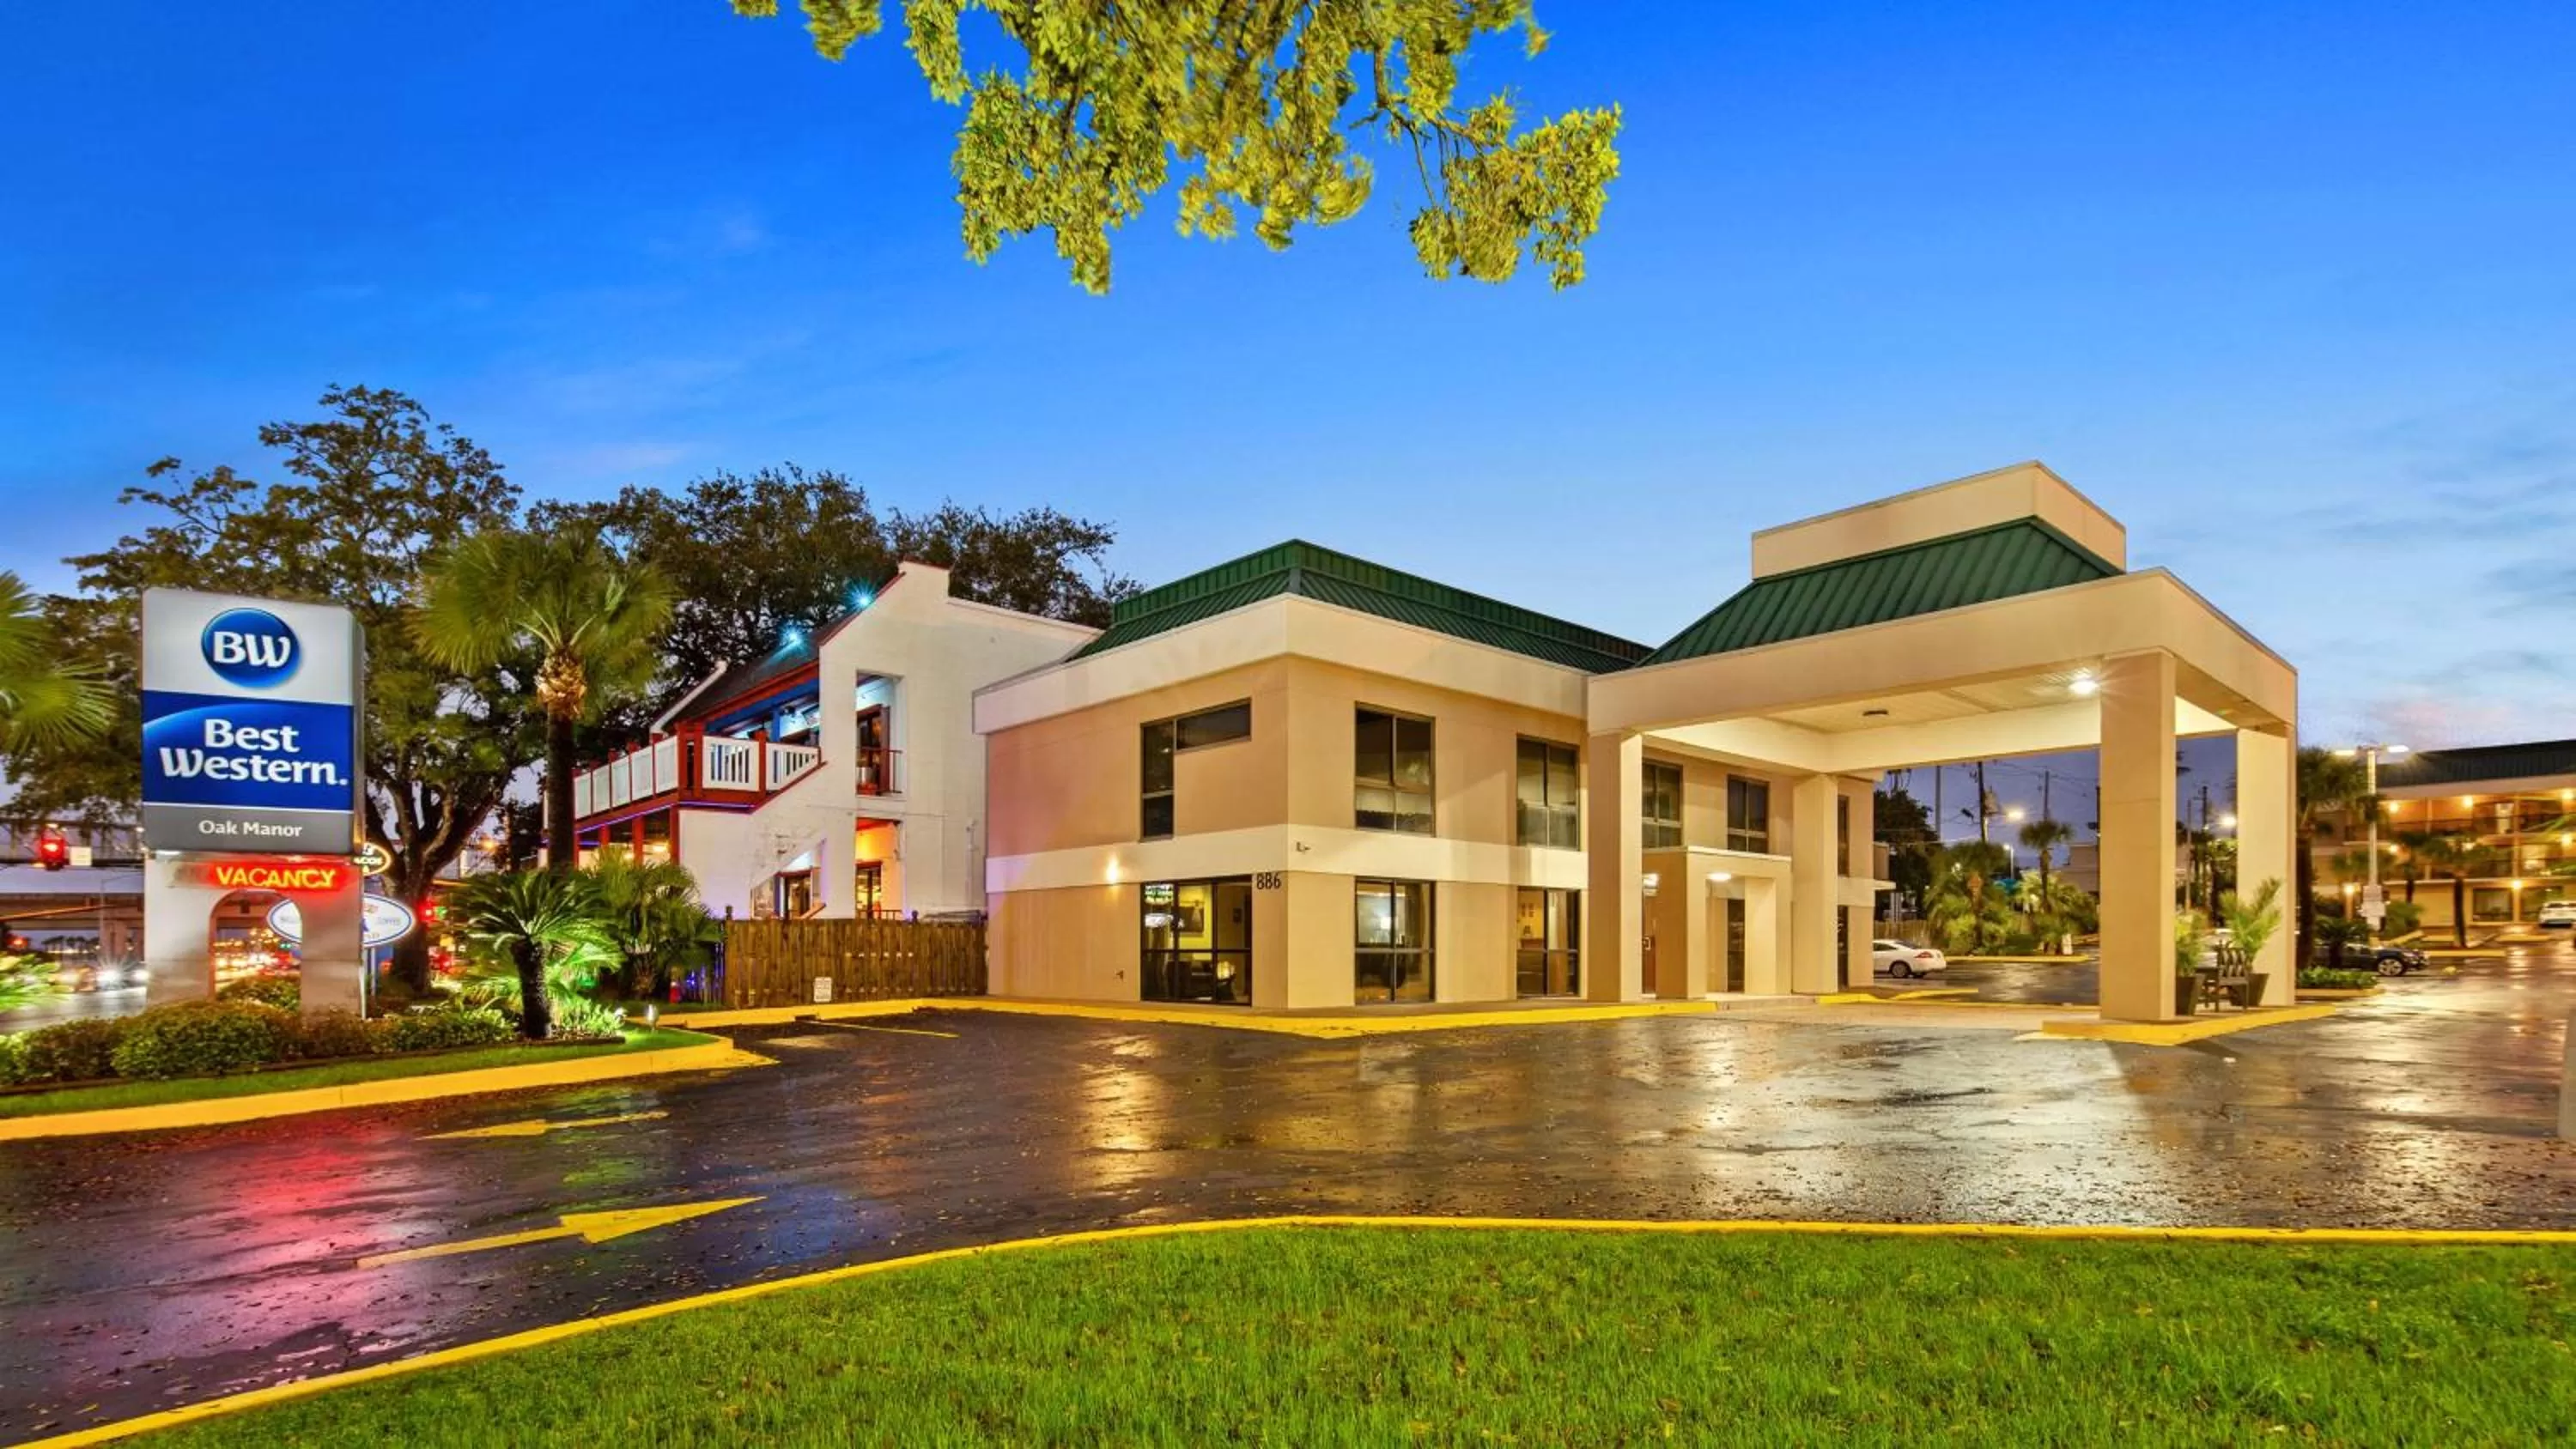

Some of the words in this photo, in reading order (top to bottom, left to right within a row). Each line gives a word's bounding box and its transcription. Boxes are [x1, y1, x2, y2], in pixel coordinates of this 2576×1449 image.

[213, 630, 292, 668] BW
[204, 718, 301, 753] Best
[198, 819, 239, 835] Oak
[242, 821, 303, 838] Manor
[216, 866, 337, 888] VACANCY
